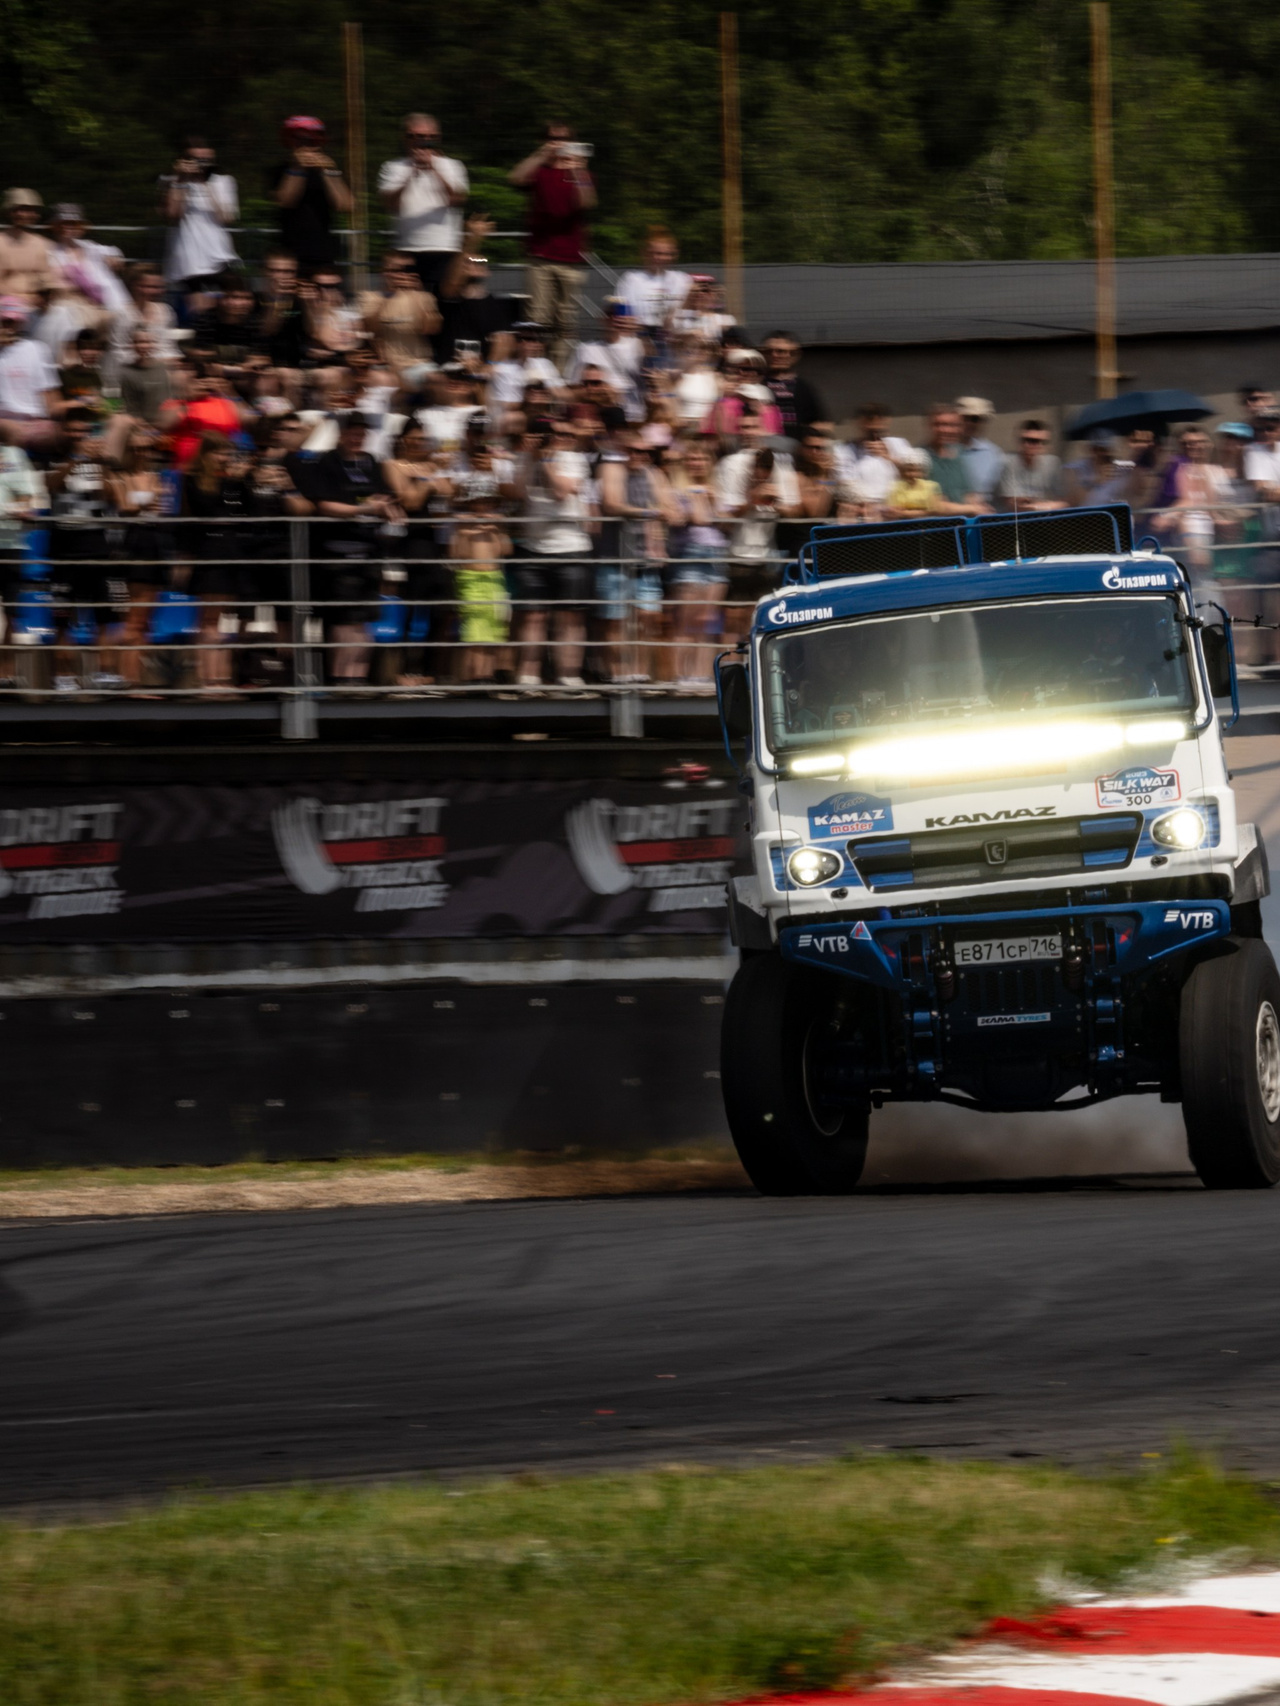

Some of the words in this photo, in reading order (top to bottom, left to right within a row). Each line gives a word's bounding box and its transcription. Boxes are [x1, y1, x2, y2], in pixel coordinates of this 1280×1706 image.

[1122, 574, 1167, 589] ГАЗПРОМ
[787, 606, 833, 623] ГАЗПРОМ
[1103, 779, 1138, 791] SILK
[1139, 775, 1171, 787] WAY
[830, 795, 866, 812] Team
[1126, 794, 1152, 806] 300
[814, 809, 885, 826] KAMAZ
[925, 806, 1057, 828] KAMAZ
[831, 822, 873, 834] master
[1180, 912, 1214, 929] VTB
[813, 935, 849, 953] VTB
[1031, 938, 1057, 953] 716
